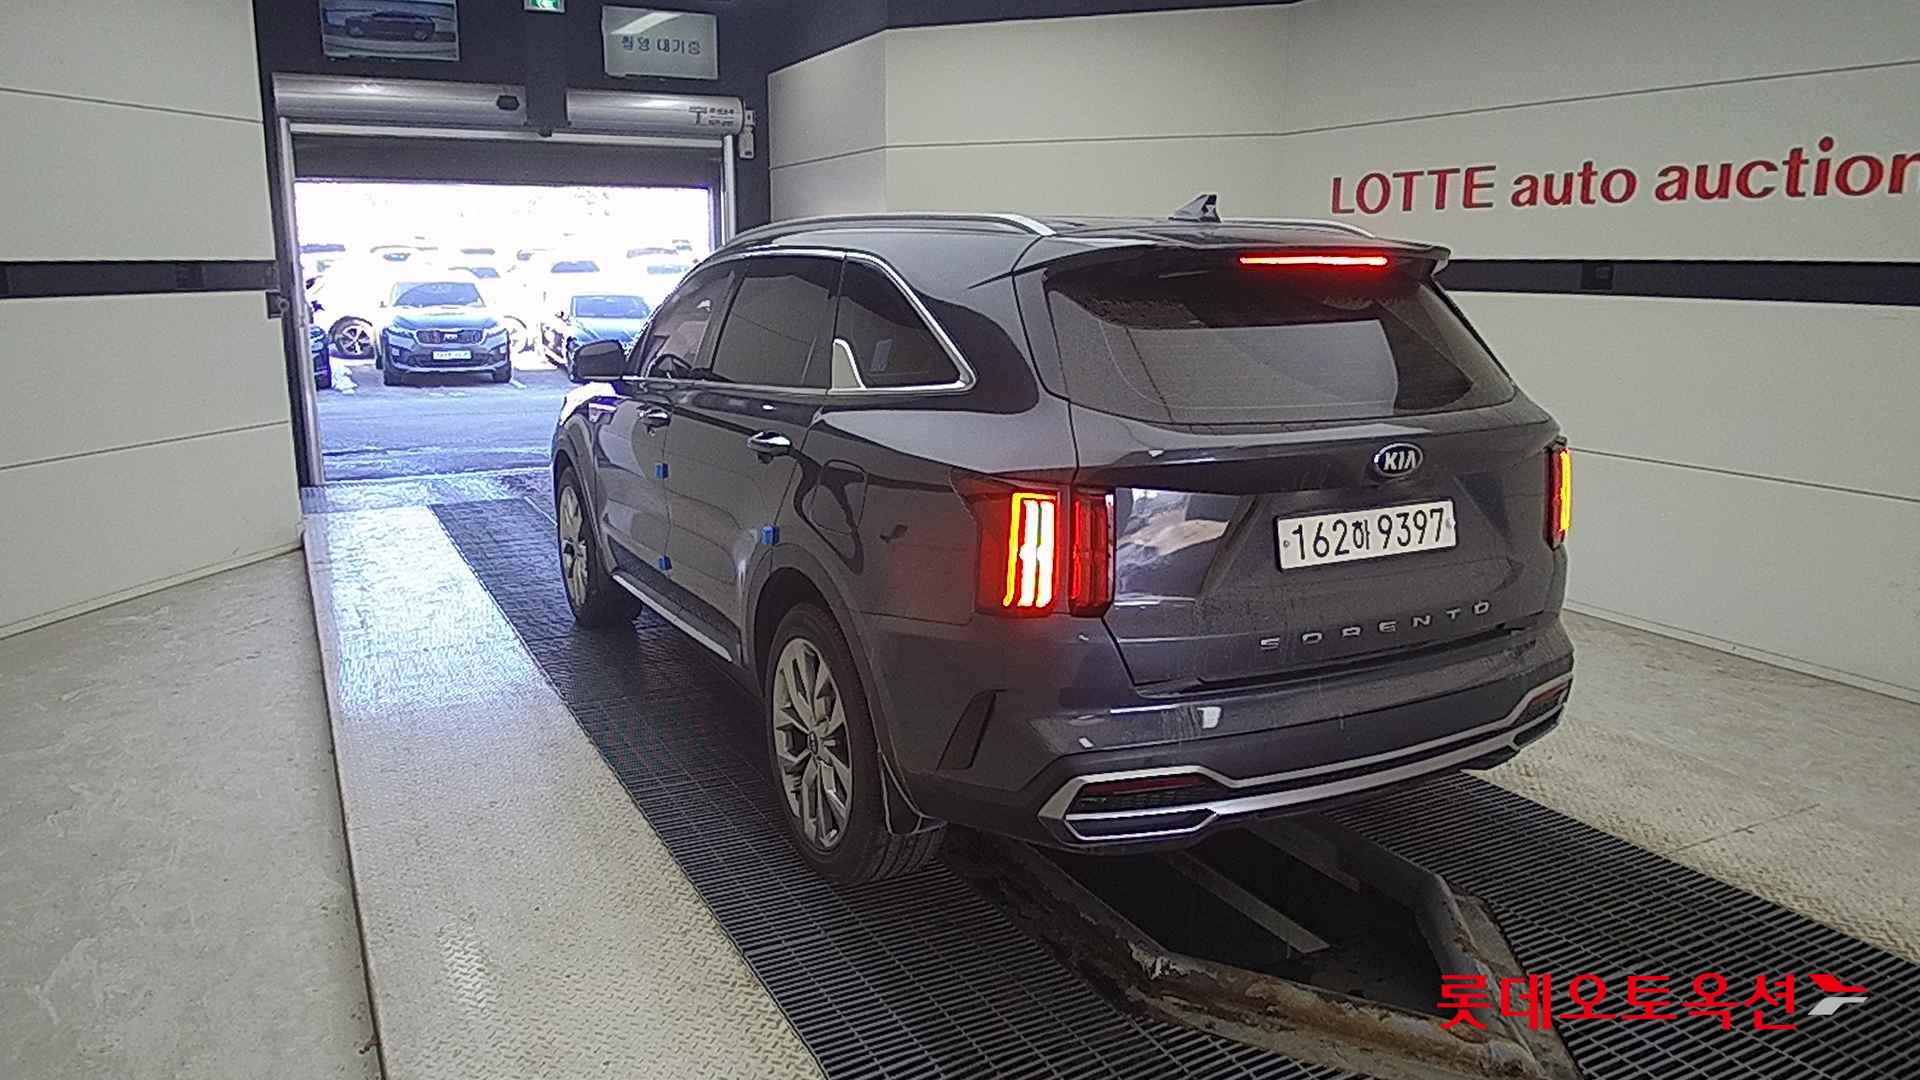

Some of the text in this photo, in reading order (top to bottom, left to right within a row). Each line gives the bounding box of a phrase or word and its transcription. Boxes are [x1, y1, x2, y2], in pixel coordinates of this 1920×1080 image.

[1331, 165, 1496, 214] LOTTE
[1510, 161, 1637, 208] auto
[1383, 450, 1417, 471] KIA
[1260, 601, 1490, 648] SORENTO
